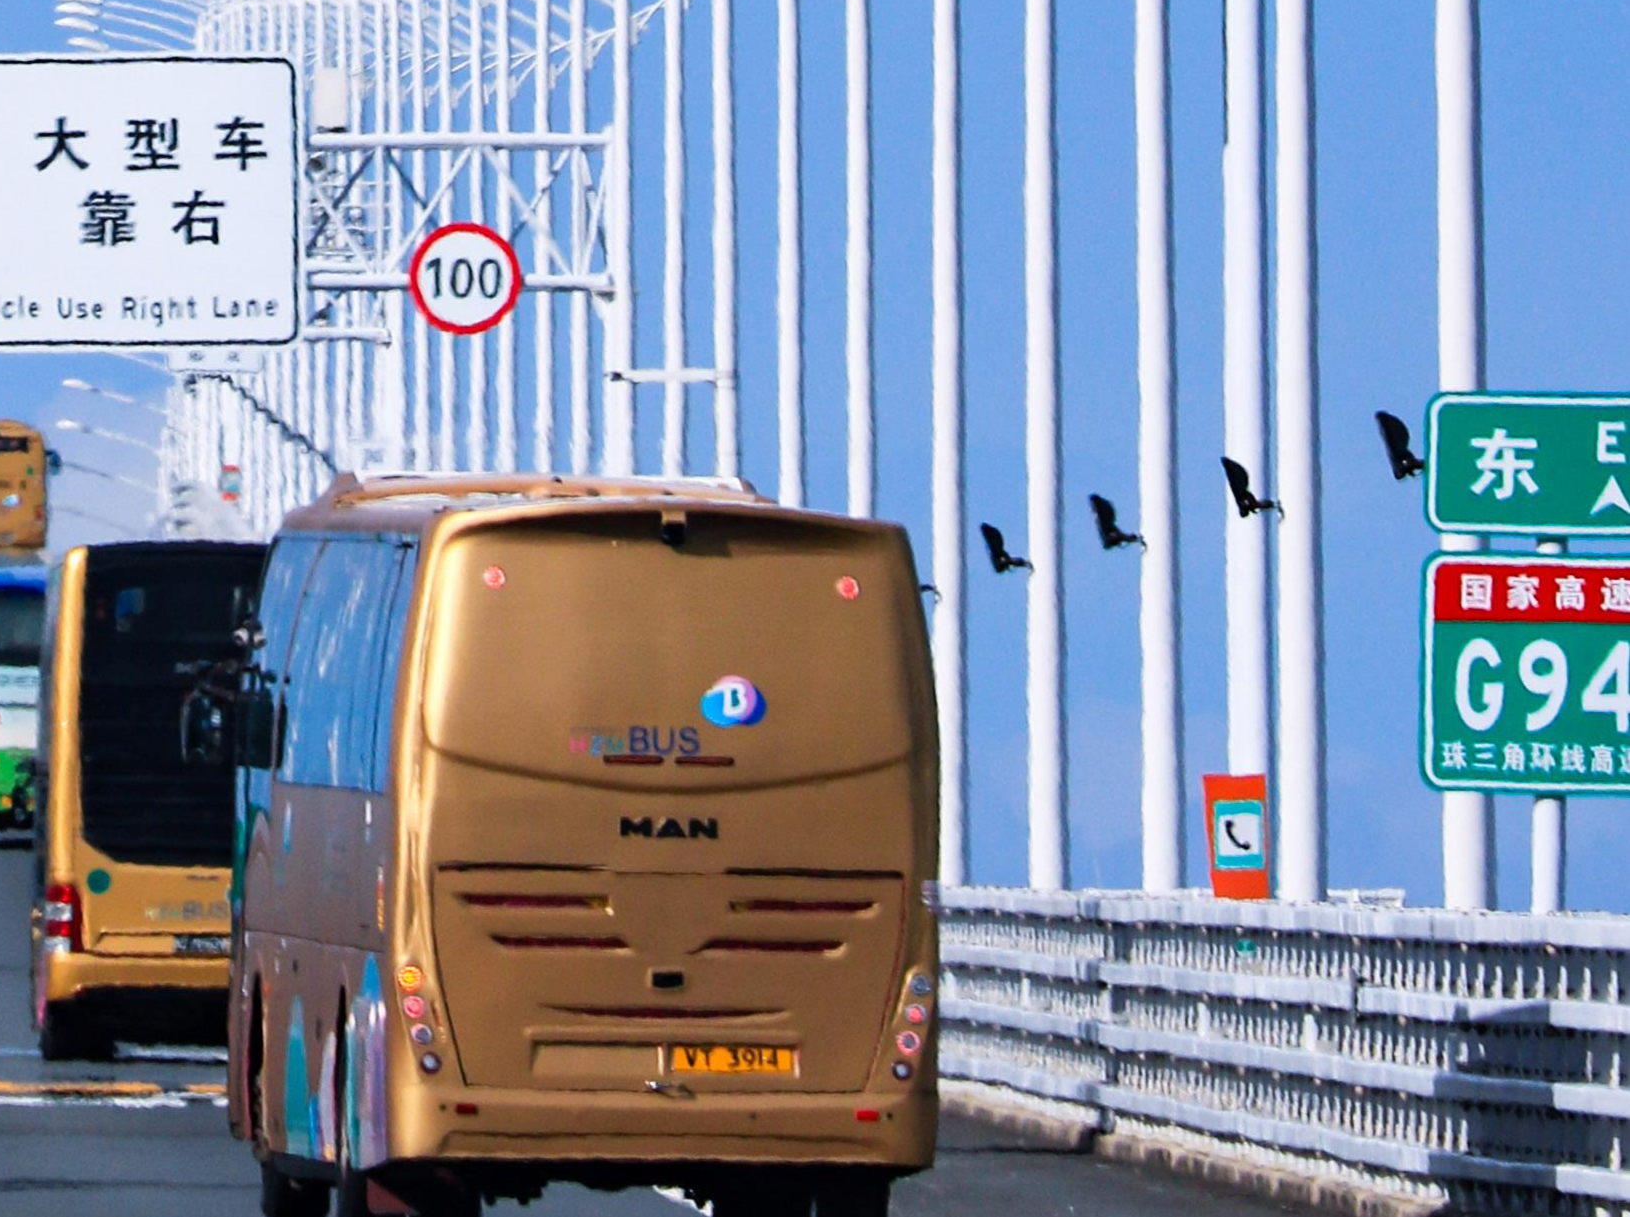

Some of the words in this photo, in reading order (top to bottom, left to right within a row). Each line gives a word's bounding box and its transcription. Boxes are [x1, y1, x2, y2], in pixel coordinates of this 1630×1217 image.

[35, 116, 267, 172] 大型车
[80, 189, 225, 247] 靠右
[426, 257, 503, 299] 100
[57, 296, 105, 320] Use
[121, 296, 198, 327] Right
[212, 295, 280, 319] Lane
[1597, 421, 1627, 463] E
[1470, 428, 1539, 500] 东
[1461, 573, 1630, 614] 国家高速
[1455, 638, 1630, 733] G94
[620, 817, 719, 839] MAN
